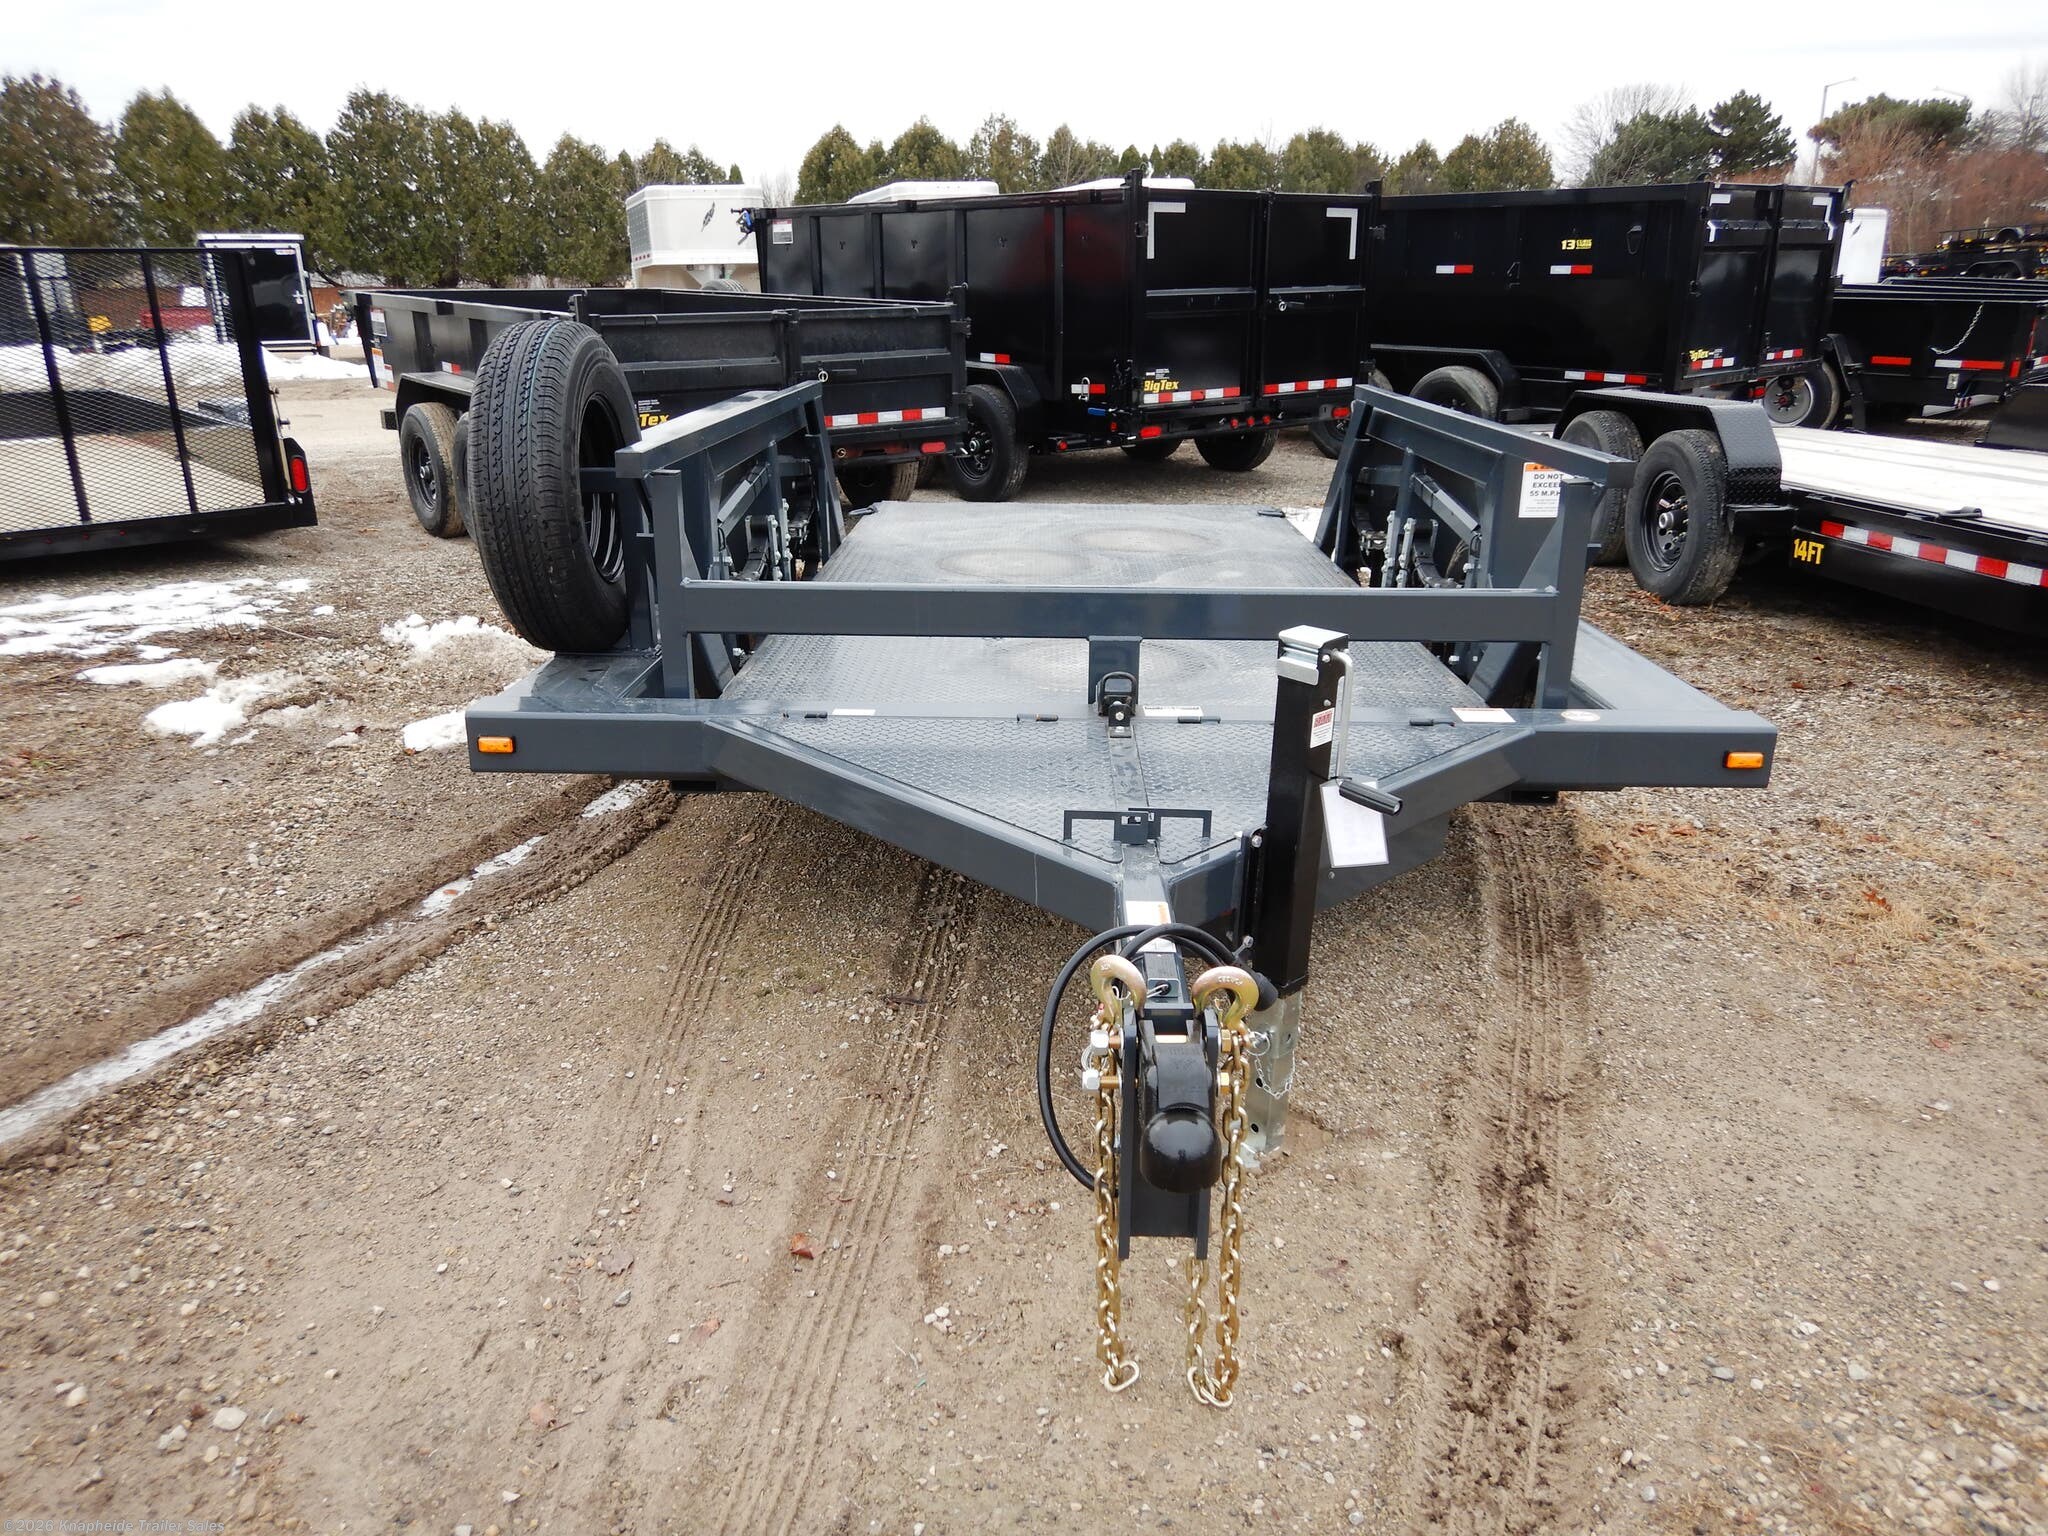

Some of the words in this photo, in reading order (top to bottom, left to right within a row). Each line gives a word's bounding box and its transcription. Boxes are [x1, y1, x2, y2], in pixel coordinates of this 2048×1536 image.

[1561, 239, 1576, 250] 13
[1143, 379, 1179, 393] BigTex
[1793, 538, 1825, 565] 14FT
